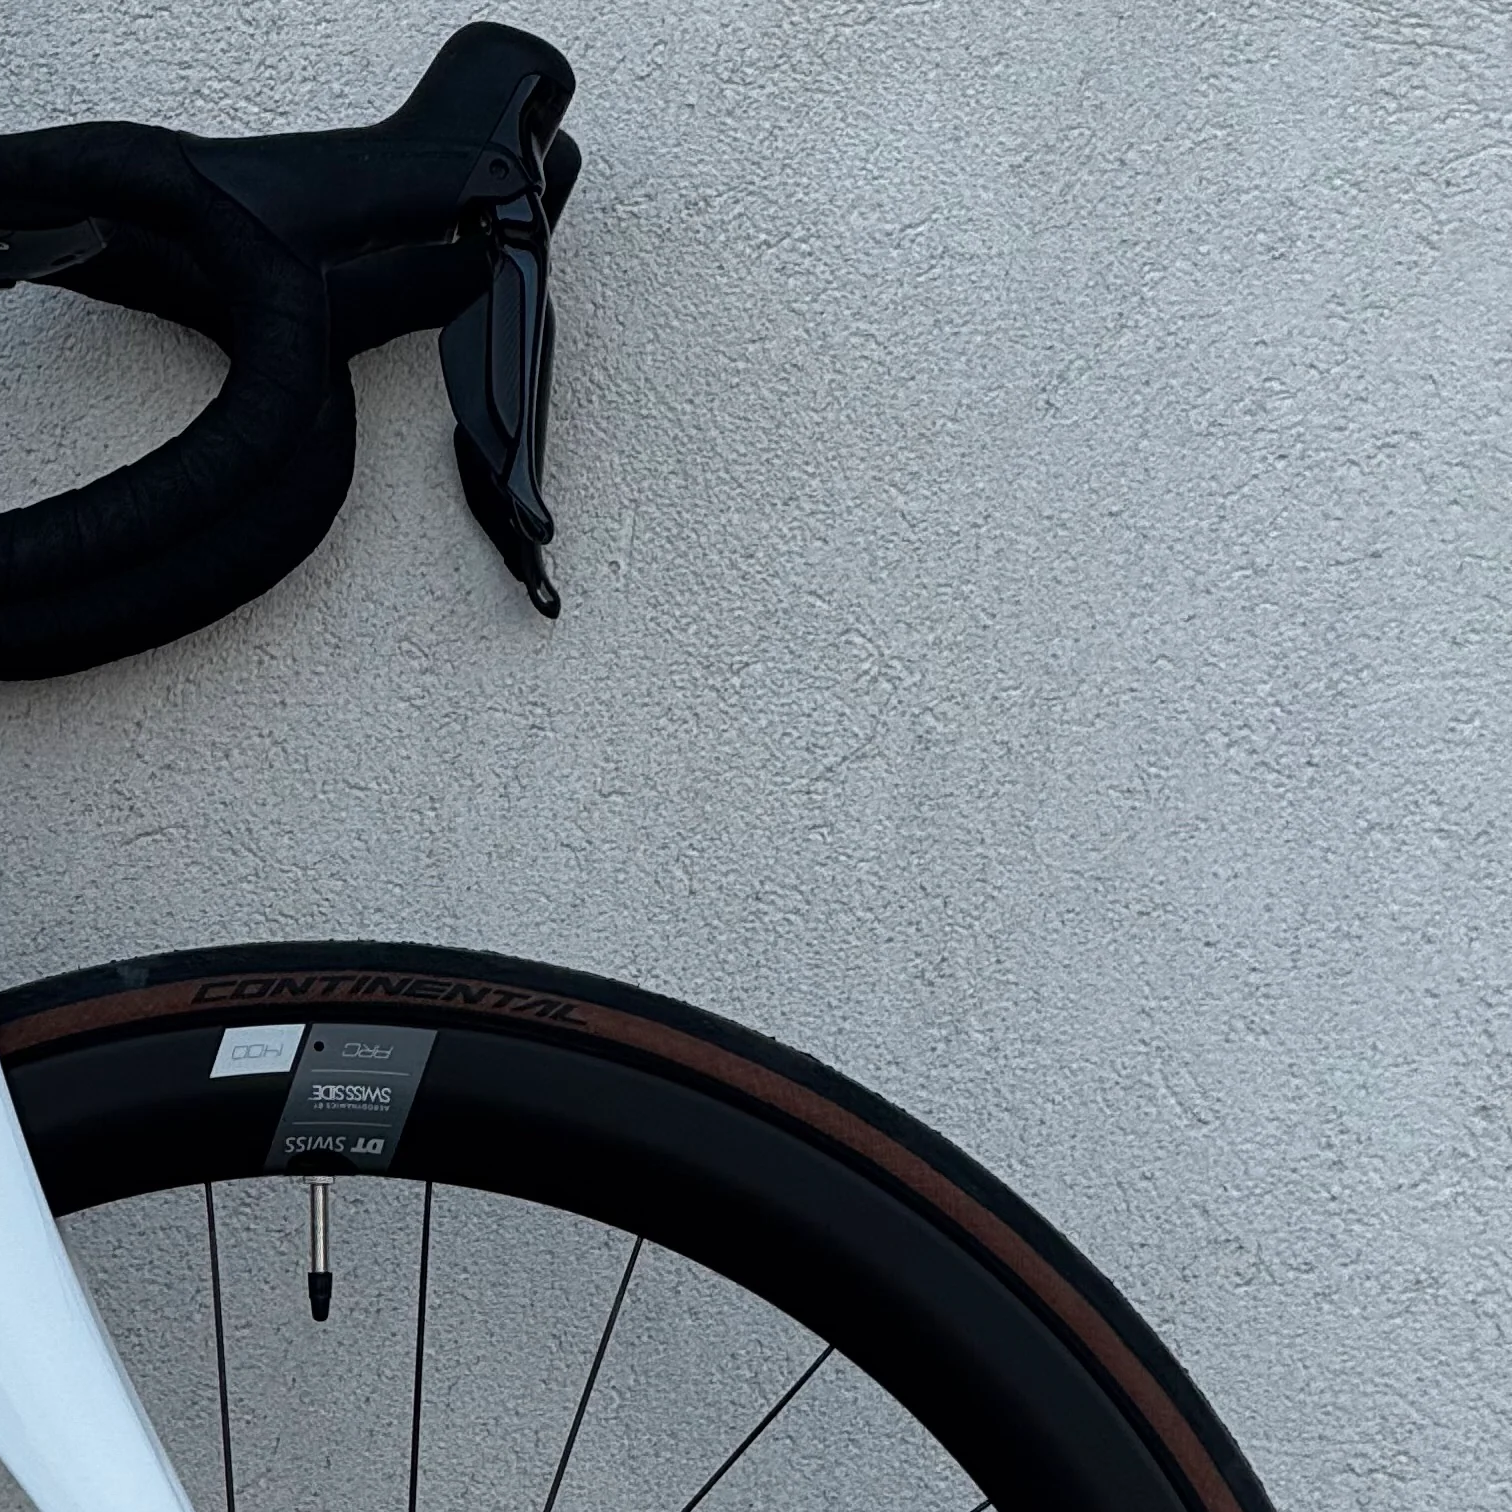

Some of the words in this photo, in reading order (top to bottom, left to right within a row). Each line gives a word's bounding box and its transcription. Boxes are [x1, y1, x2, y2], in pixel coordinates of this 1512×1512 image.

[191, 973, 588, 1026] CONTINENTAL
[231, 1044, 284, 1060] 1400
[341, 1041, 394, 1060] ARC
[285, 1136, 346, 1153] SWISS
[351, 1138, 385, 1154] DT
